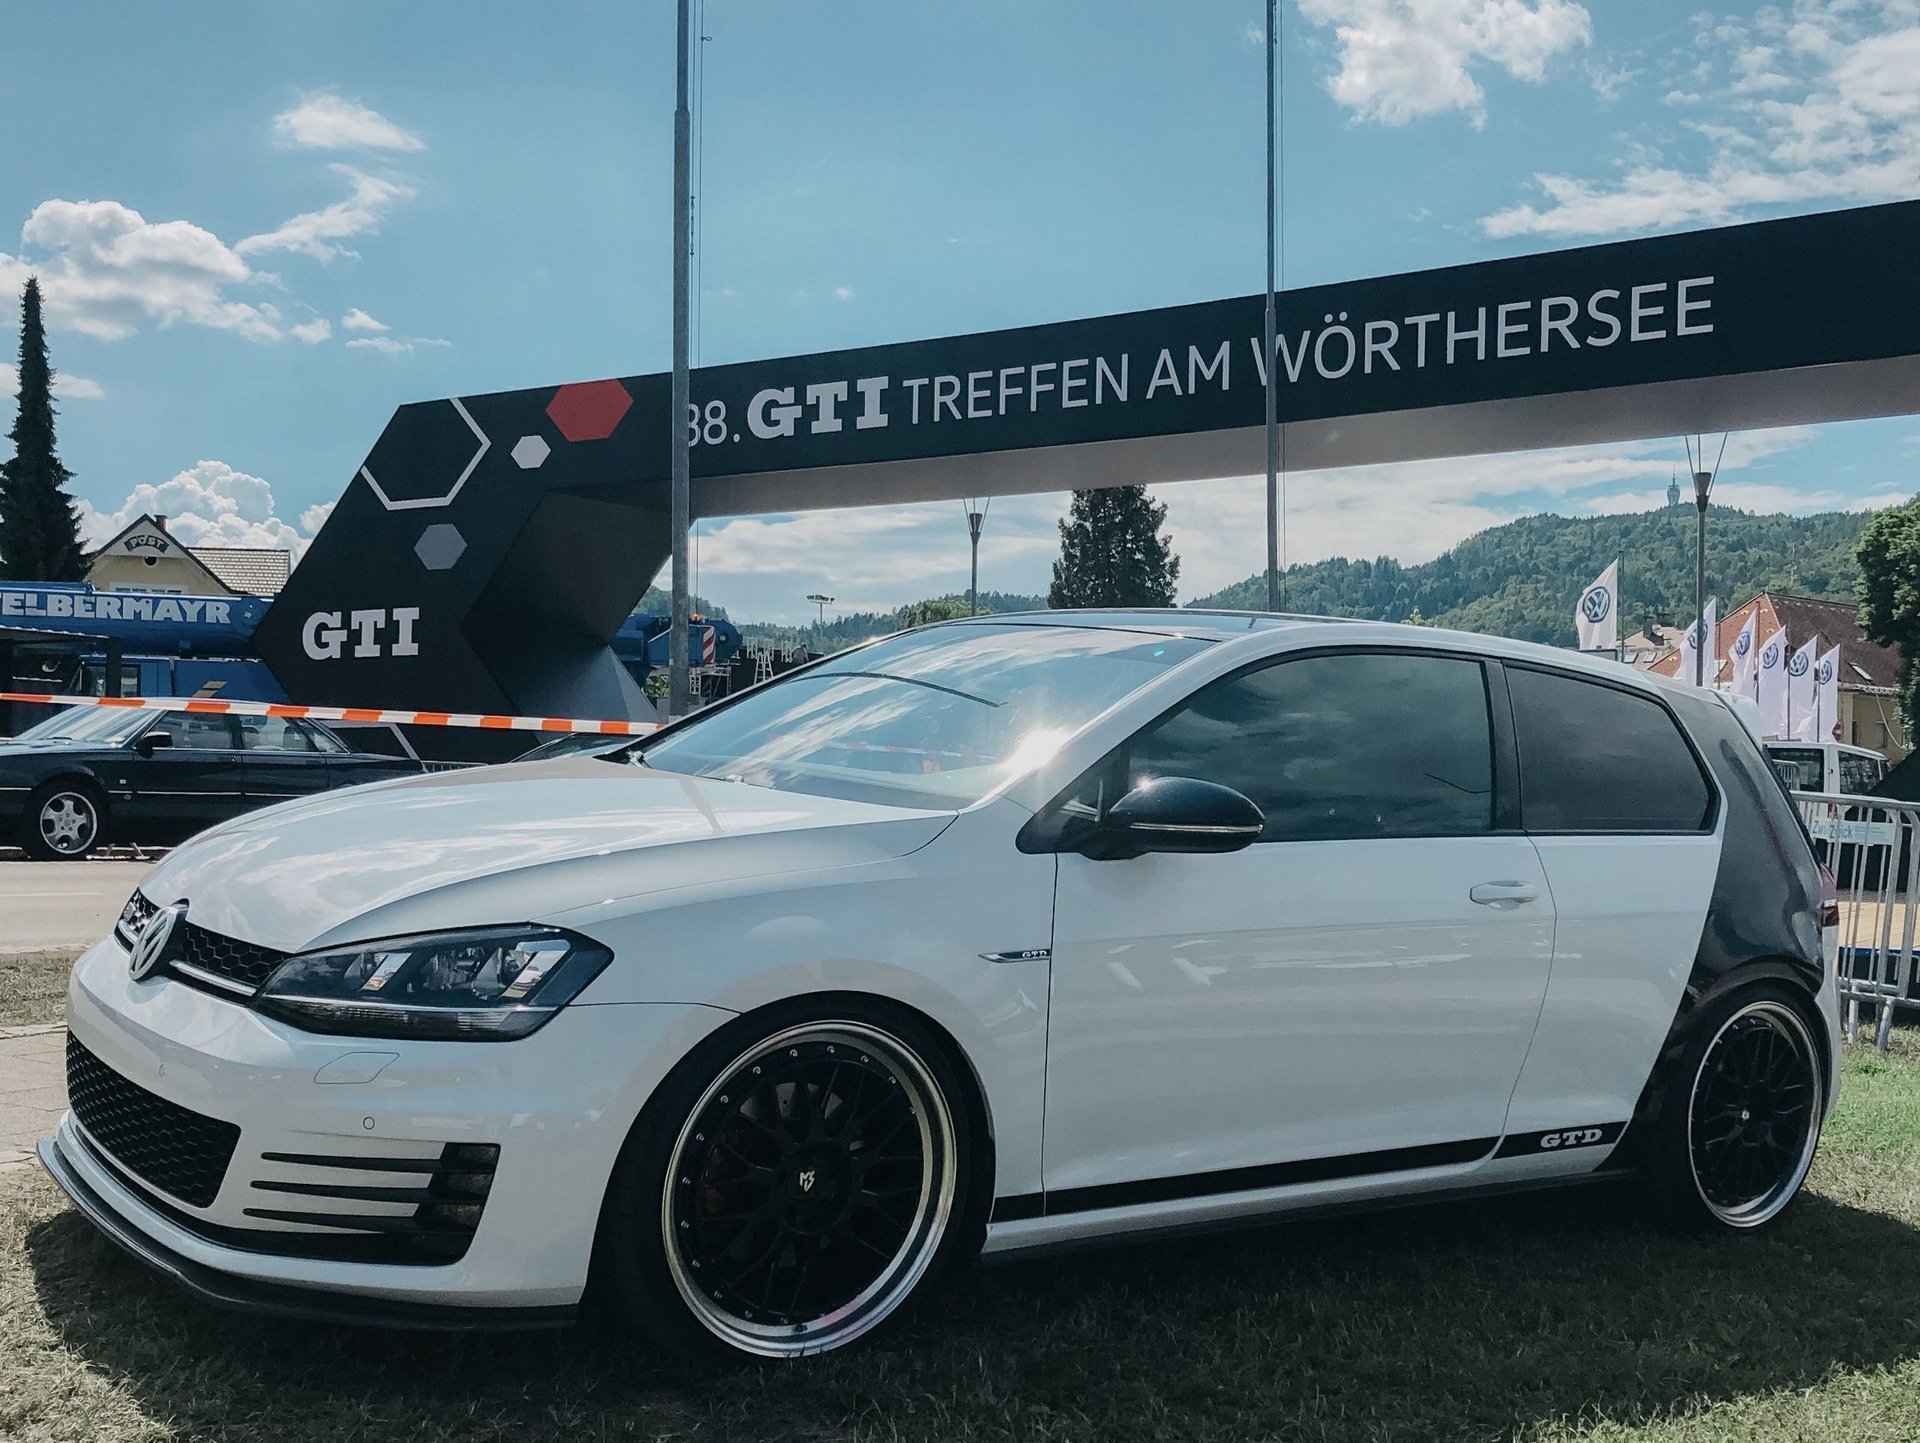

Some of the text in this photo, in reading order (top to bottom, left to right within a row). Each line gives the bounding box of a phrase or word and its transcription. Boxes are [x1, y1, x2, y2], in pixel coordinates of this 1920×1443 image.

[747, 376, 889, 439] GTI
[903, 353, 1129, 424] TREFFEN
[1146, 341, 1230, 399] AM
[1250, 276, 1714, 386] WÖRTHERSEE
[130, 536, 164, 548] POST
[0, 593, 230, 624] ELBERMAYR
[302, 607, 419, 660] GTI
[1022, 950, 1047, 958] GTD
[1540, 1128, 1603, 1148] GTD
